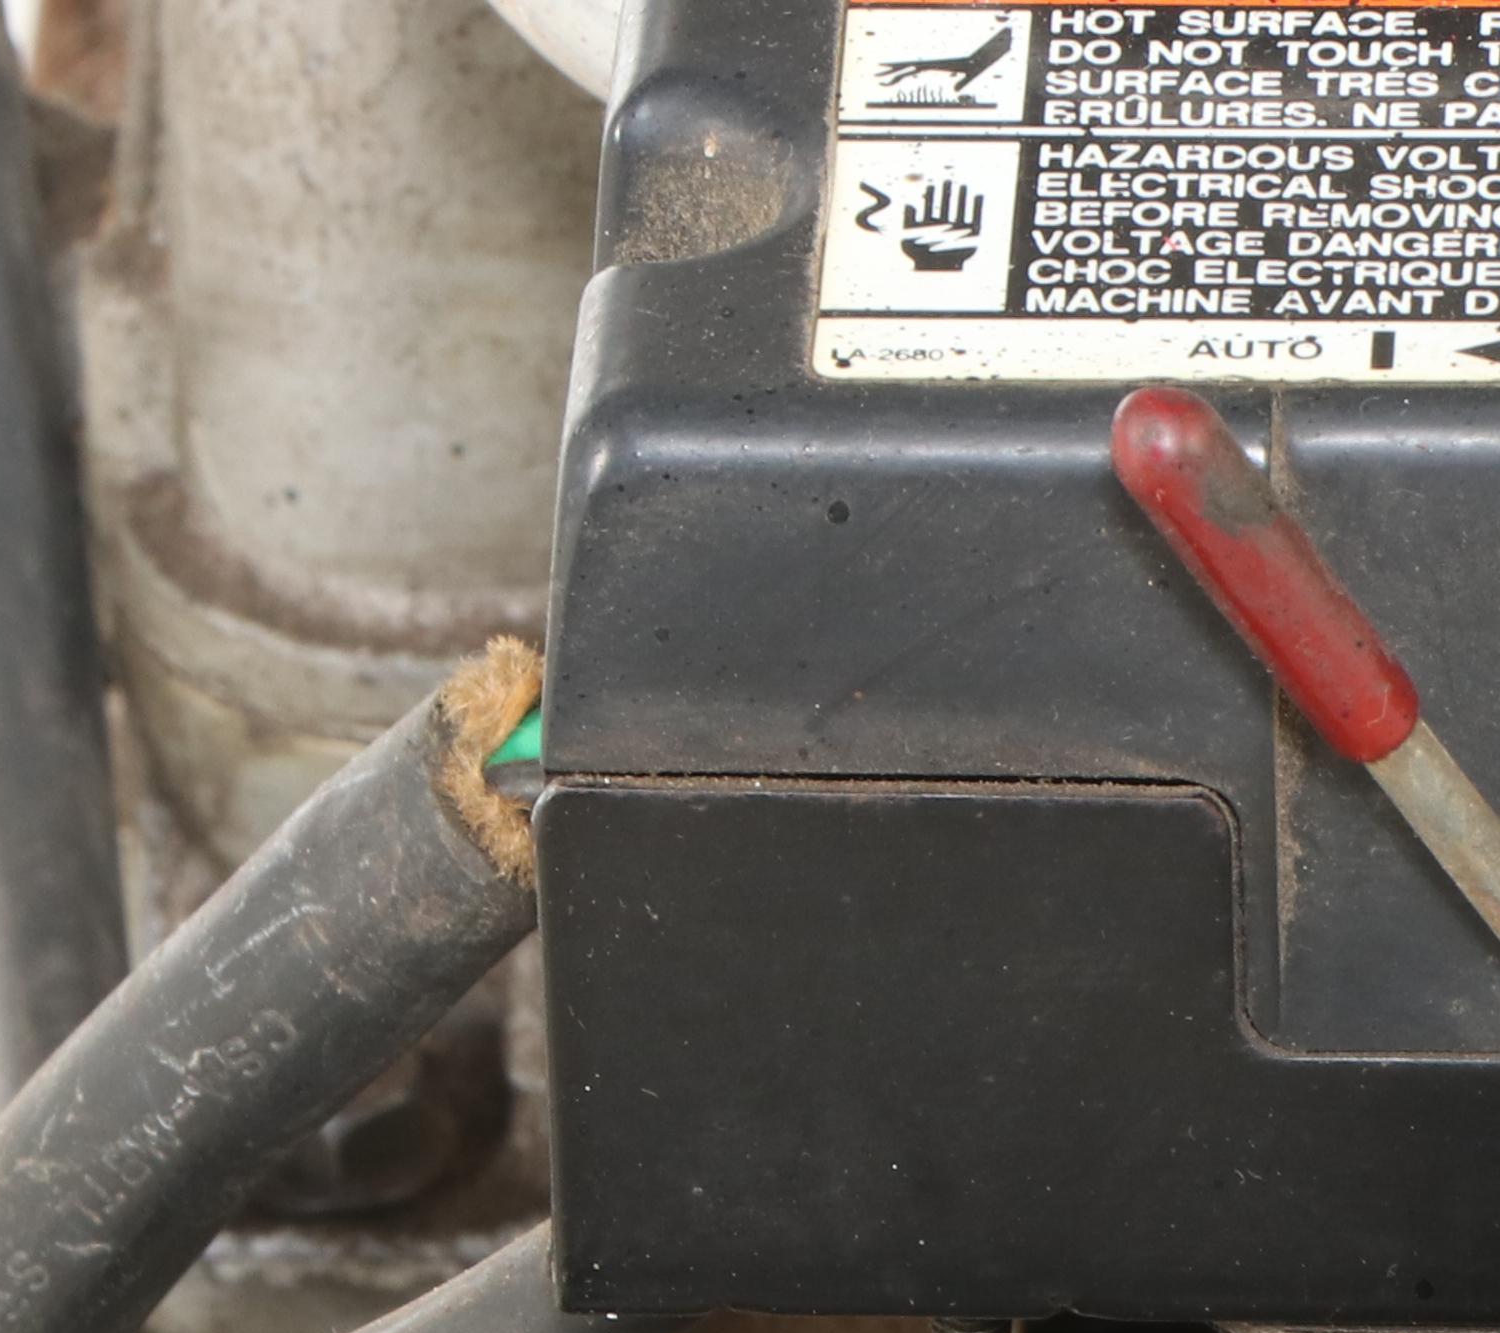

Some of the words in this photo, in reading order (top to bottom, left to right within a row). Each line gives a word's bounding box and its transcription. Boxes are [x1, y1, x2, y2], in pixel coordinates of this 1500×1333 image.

[1050, 9, 1155, 35] HOT
[1177, 9, 1429, 35] SURFACE.
[1048, 40, 1121, 66] DO
[1148, 40, 1249, 66] NOT
[1277, 41, 1452, 67] TOUCH
[1045, 70, 1282, 96] SURFACE
[1352, 102, 1420, 128] NE
[1038, 143, 1354, 170] HAZARDOUS
[1035, 173, 1347, 199] ELECTRICAL
[1032, 202, 1240, 228] BEFORE
[1031, 230, 1265, 256] VOLTAGE
[1026, 259, 1171, 286] CHOC
[1024, 288, 1252, 314] MACHINE
[1273, 289, 1444, 315] AVANT
[1186, 334, 1325, 361] AUTO
